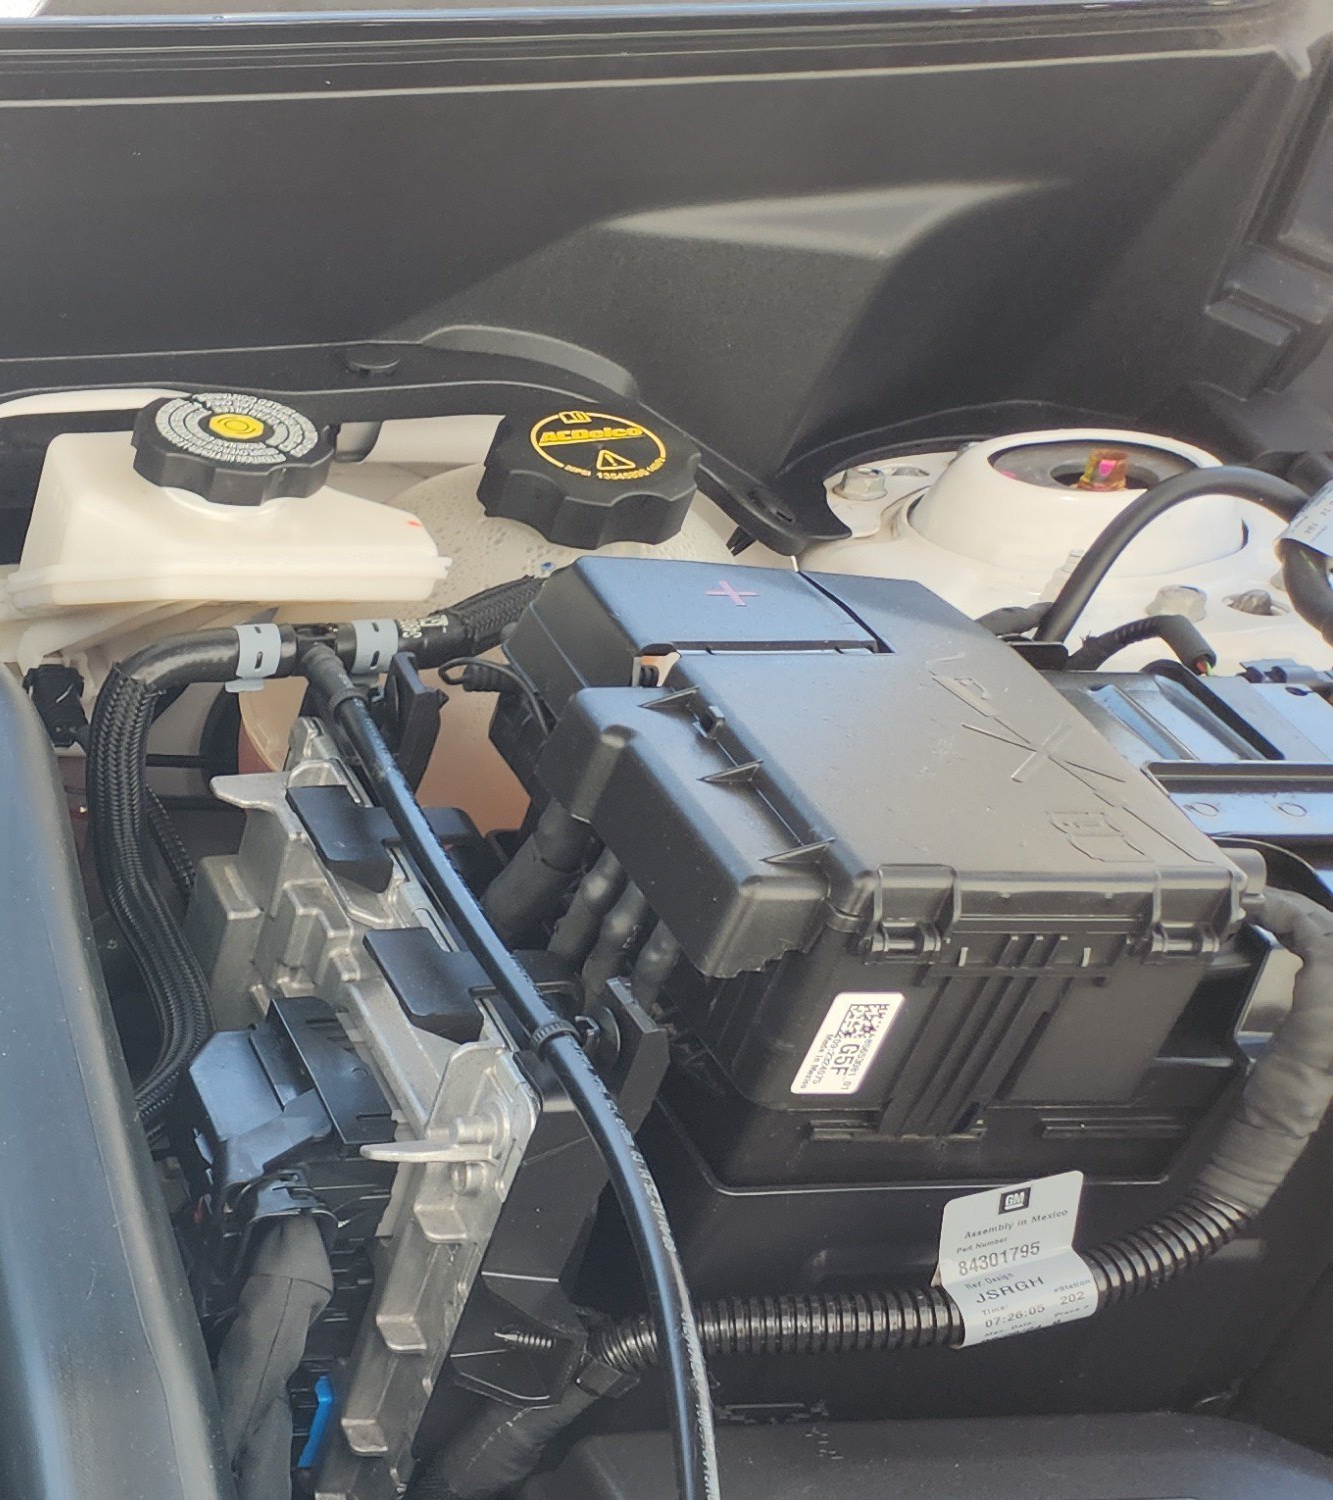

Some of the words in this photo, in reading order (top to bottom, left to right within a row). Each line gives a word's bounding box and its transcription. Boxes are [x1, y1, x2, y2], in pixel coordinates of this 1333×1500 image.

[539, 427, 643, 442] ACDelco
[831, 1044, 860, 1076] G5F
[1005, 1191, 1026, 1208] GM
[964, 1223, 1014, 1239] Assembly
[1031, 1209, 1069, 1223] Mexico
[958, 1241, 1041, 1277] 84301795
[1060, 1291, 1085, 1306] 202
[985, 1304, 1046, 1329] 07:26:05
